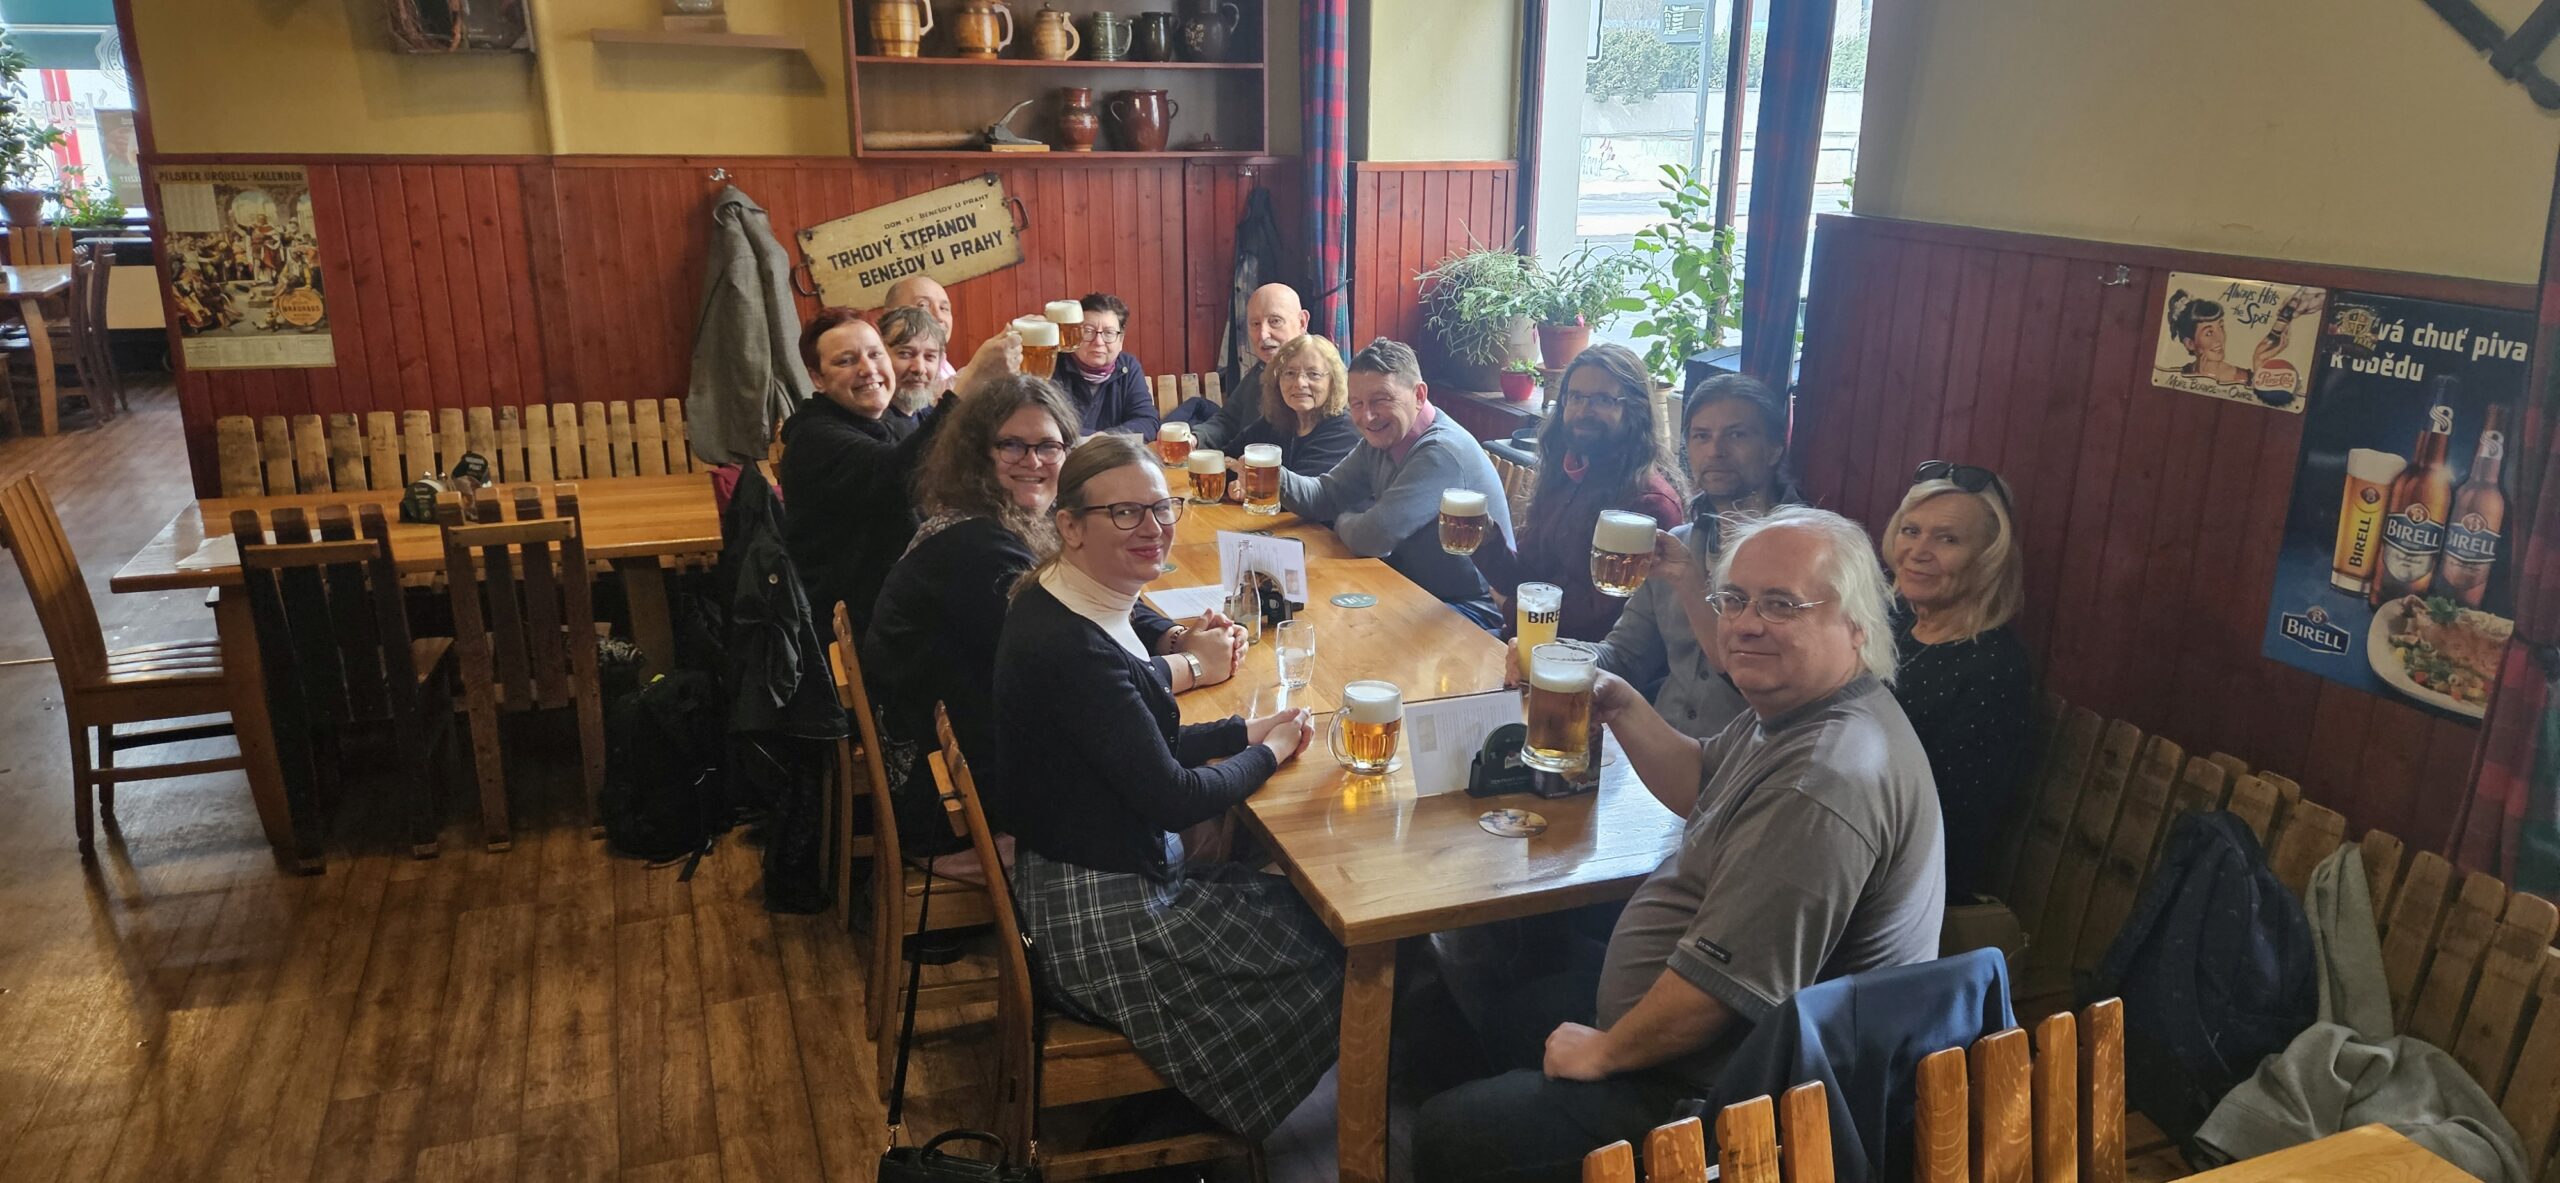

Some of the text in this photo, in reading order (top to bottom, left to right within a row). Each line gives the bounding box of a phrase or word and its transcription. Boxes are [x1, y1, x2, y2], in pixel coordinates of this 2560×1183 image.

[962, 193, 990, 206] PRAHY
[827, 235, 892, 271] TRHOVÝ
[858, 229, 1003, 288] BENEŠOV U PRAHY
[2218, 282, 2257, 305] Always
[2237, 302, 2273, 329] Spot
[2412, 322, 2469, 353] chuť
[2471, 331, 2529, 362] piva
[2349, 517, 2372, 568] BIRELL
[2386, 518, 2439, 548] BIRELL
[2286, 617, 2342, 650] BIRELL
